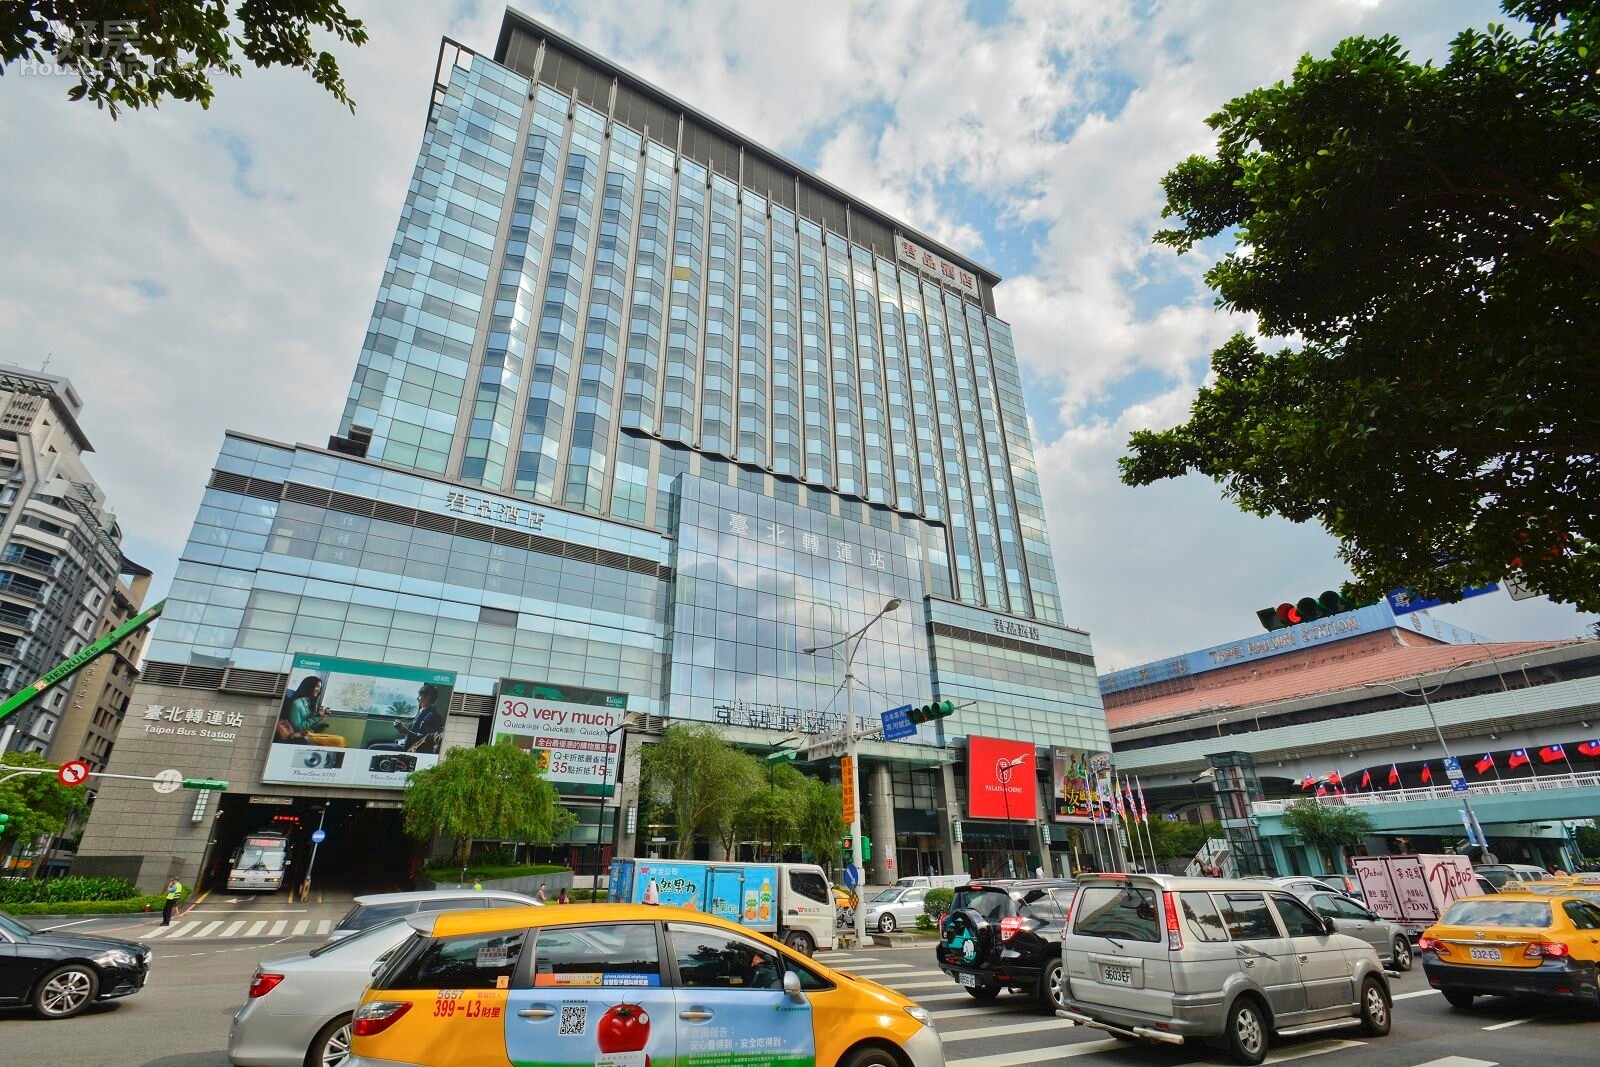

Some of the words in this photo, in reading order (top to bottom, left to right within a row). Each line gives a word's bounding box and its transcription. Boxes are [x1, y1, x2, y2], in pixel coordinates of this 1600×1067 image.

[446, 491, 545, 531] 君品酒店
[729, 513, 886, 570] 臺北轉運站
[1209, 646, 1244, 664] TAIPEI
[1301, 616, 1361, 643] STATION
[46, 647, 100, 683] HERKULES
[301, 659, 321, 668] Canon
[144, 705, 245, 728] 臺北轉運站
[502, 701, 529, 718] 3Q
[533, 706, 568, 726] very
[571, 712, 614, 727] much
[144, 724, 175, 735] Taipei
[177, 727, 197, 736] Bus
[200, 729, 236, 740] Station
[985, 784, 1002, 792] PALAIS
[1373, 903, 1394, 911] 0097
[1471, 949, 1501, 961] 332-E5
[436, 989, 466, 1000] 5657
[433, 999, 481, 1018] 399-L3
[481, 1007, 501, 1018] 財星
